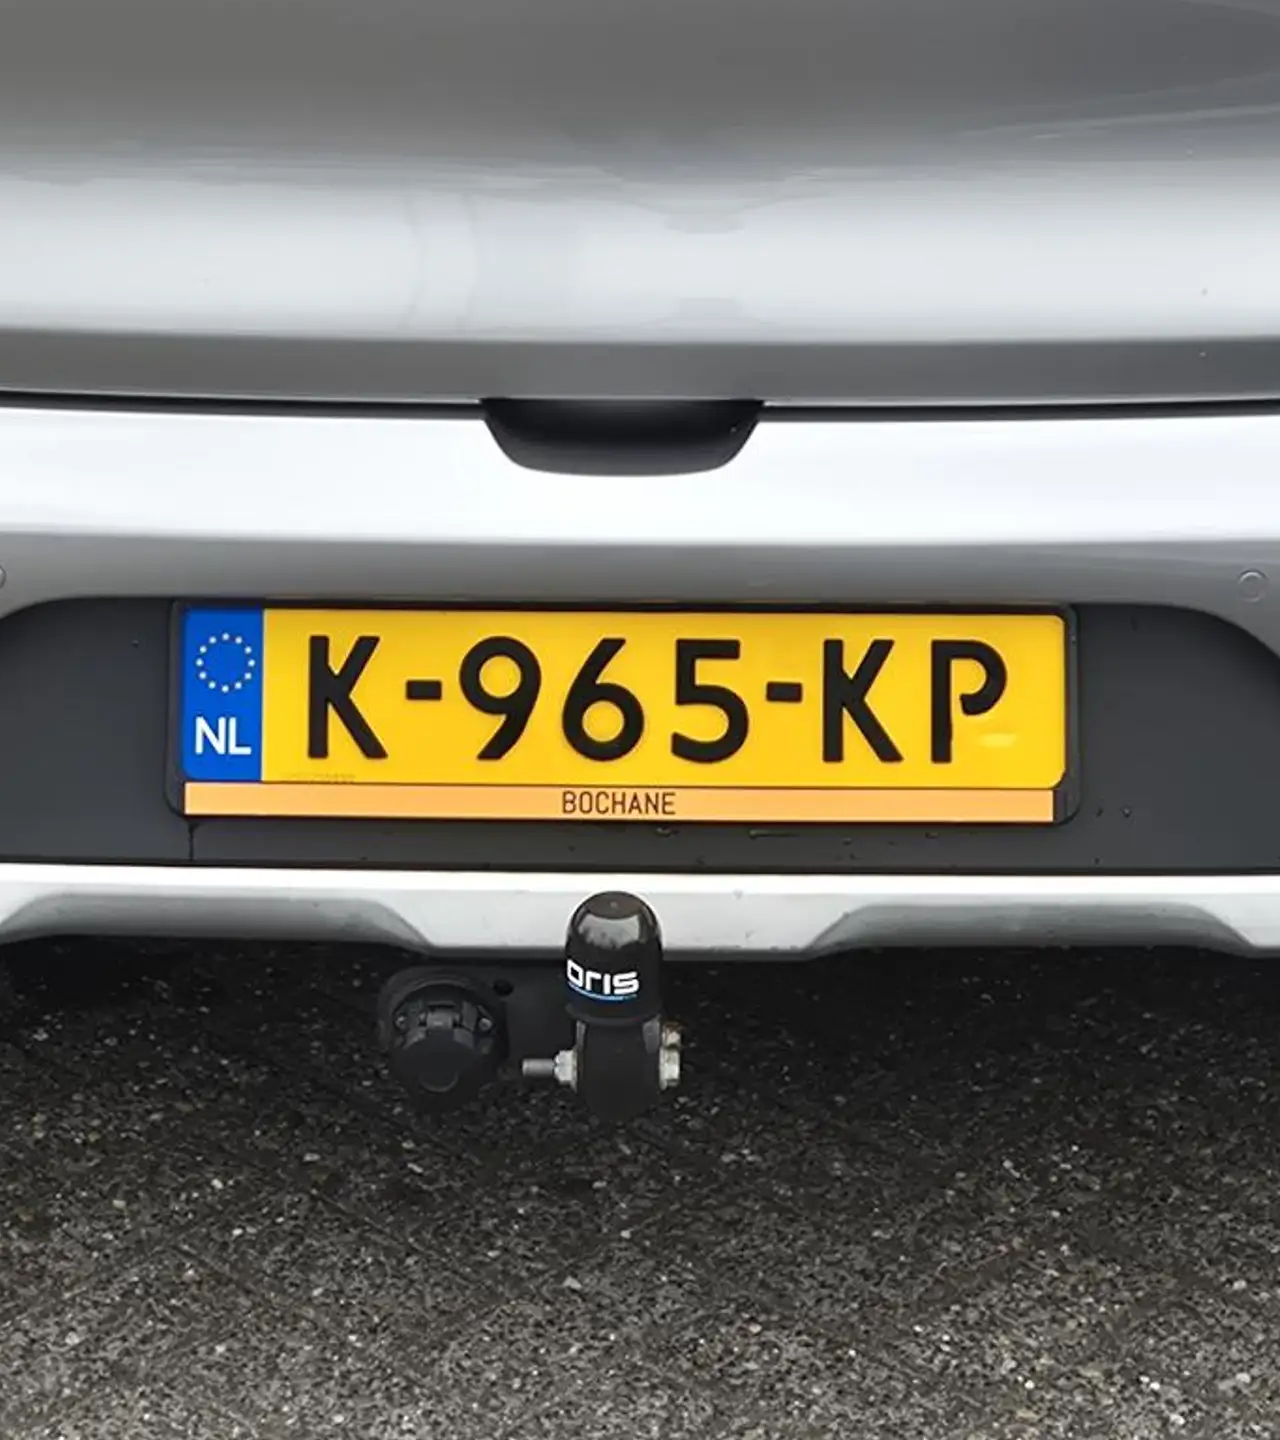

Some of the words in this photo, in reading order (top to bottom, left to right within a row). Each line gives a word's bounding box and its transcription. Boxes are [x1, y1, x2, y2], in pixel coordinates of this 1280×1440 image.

[195, 716, 252, 755] NL
[308, 635, 1007, 764] K-965-KP
[562, 791, 676, 815] BOCHANE
